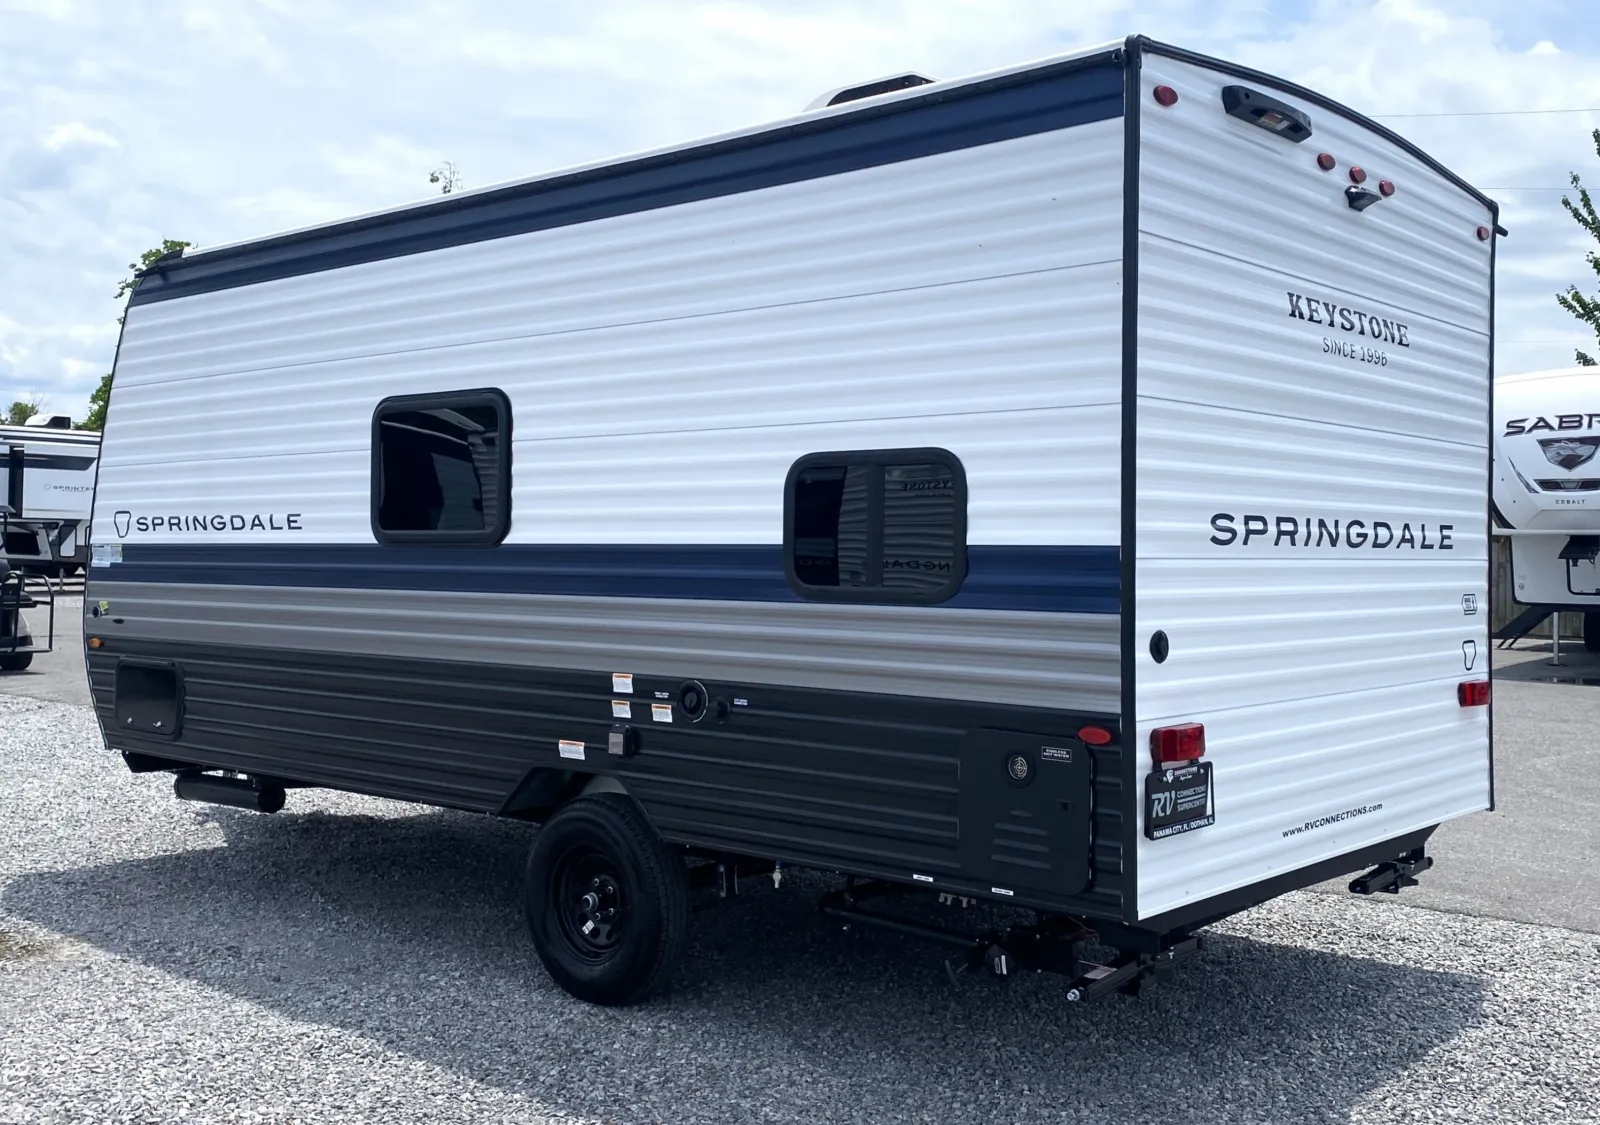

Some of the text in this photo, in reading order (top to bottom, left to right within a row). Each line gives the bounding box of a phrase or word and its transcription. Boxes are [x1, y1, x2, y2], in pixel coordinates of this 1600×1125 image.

[1286, 292, 1410, 348] KEYSTONE
[1322, 337, 1388, 367] SINCE 1996
[136, 513, 303, 532] SPRINGDALE
[1209, 512, 1454, 550] SPRINGDALE
[1151, 790, 1176, 818] RV
[1176, 784, 1207, 798] CONNECTIONS
[1153, 827, 1172, 839] PANAMA
[1282, 803, 1383, 838] www.RVCONNECTIONS.com
